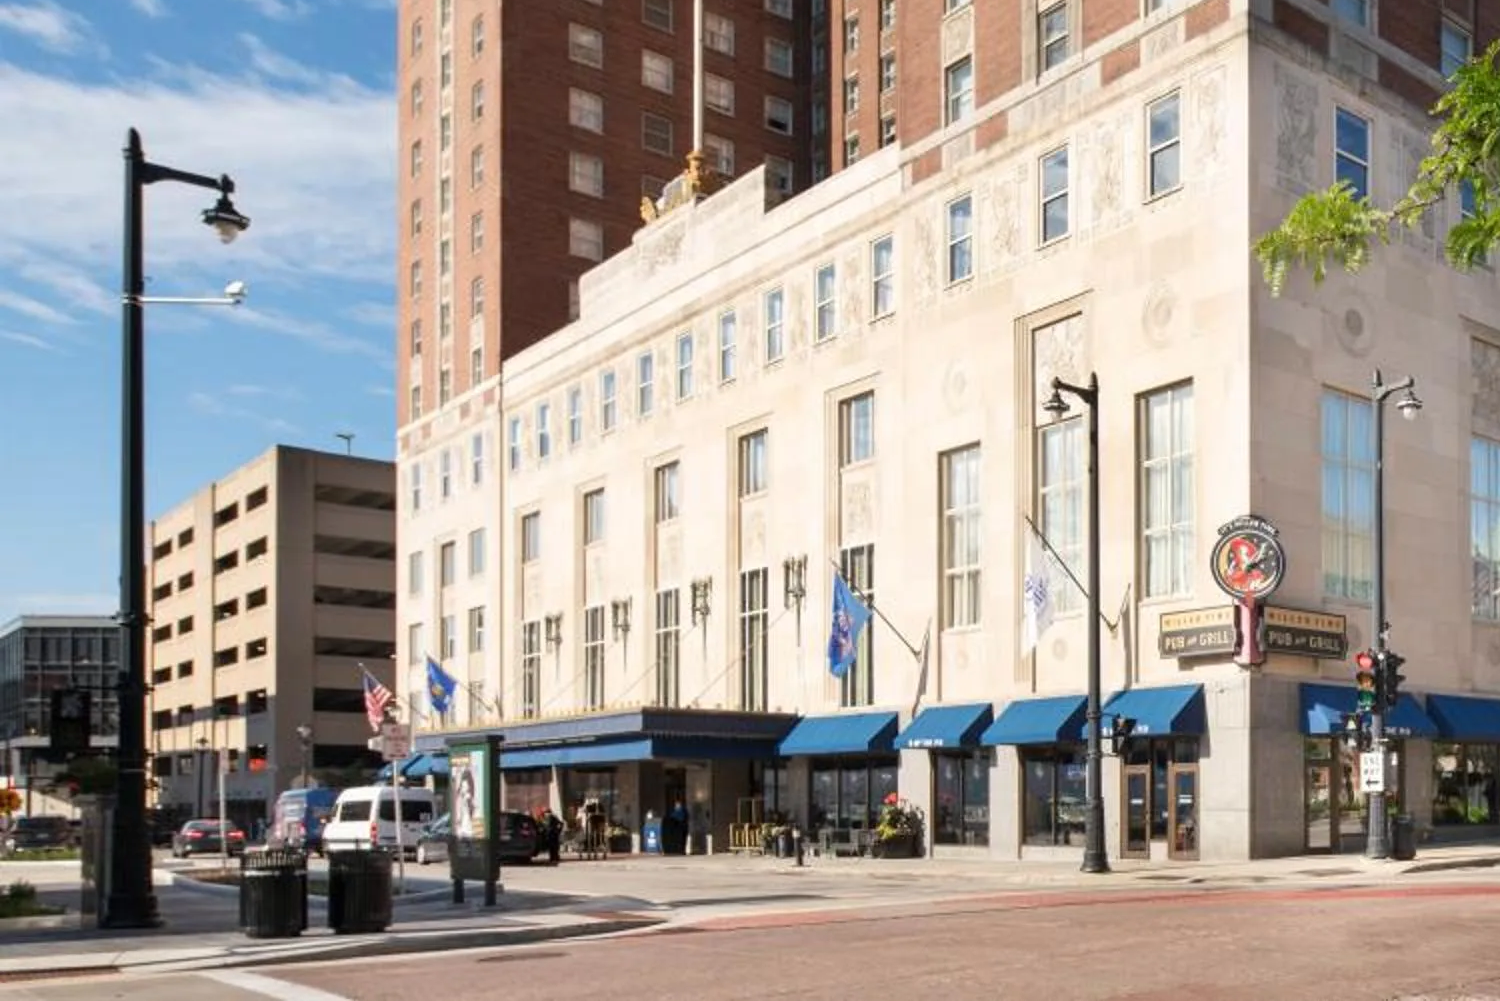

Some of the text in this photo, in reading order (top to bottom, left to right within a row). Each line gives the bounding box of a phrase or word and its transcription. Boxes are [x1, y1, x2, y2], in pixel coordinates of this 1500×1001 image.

[1165, 635, 1185, 651] PUB
[1200, 630, 1230, 646] GRILL
[1268, 630, 1293, 647] PUB
[1309, 635, 1341, 652] GRILL
